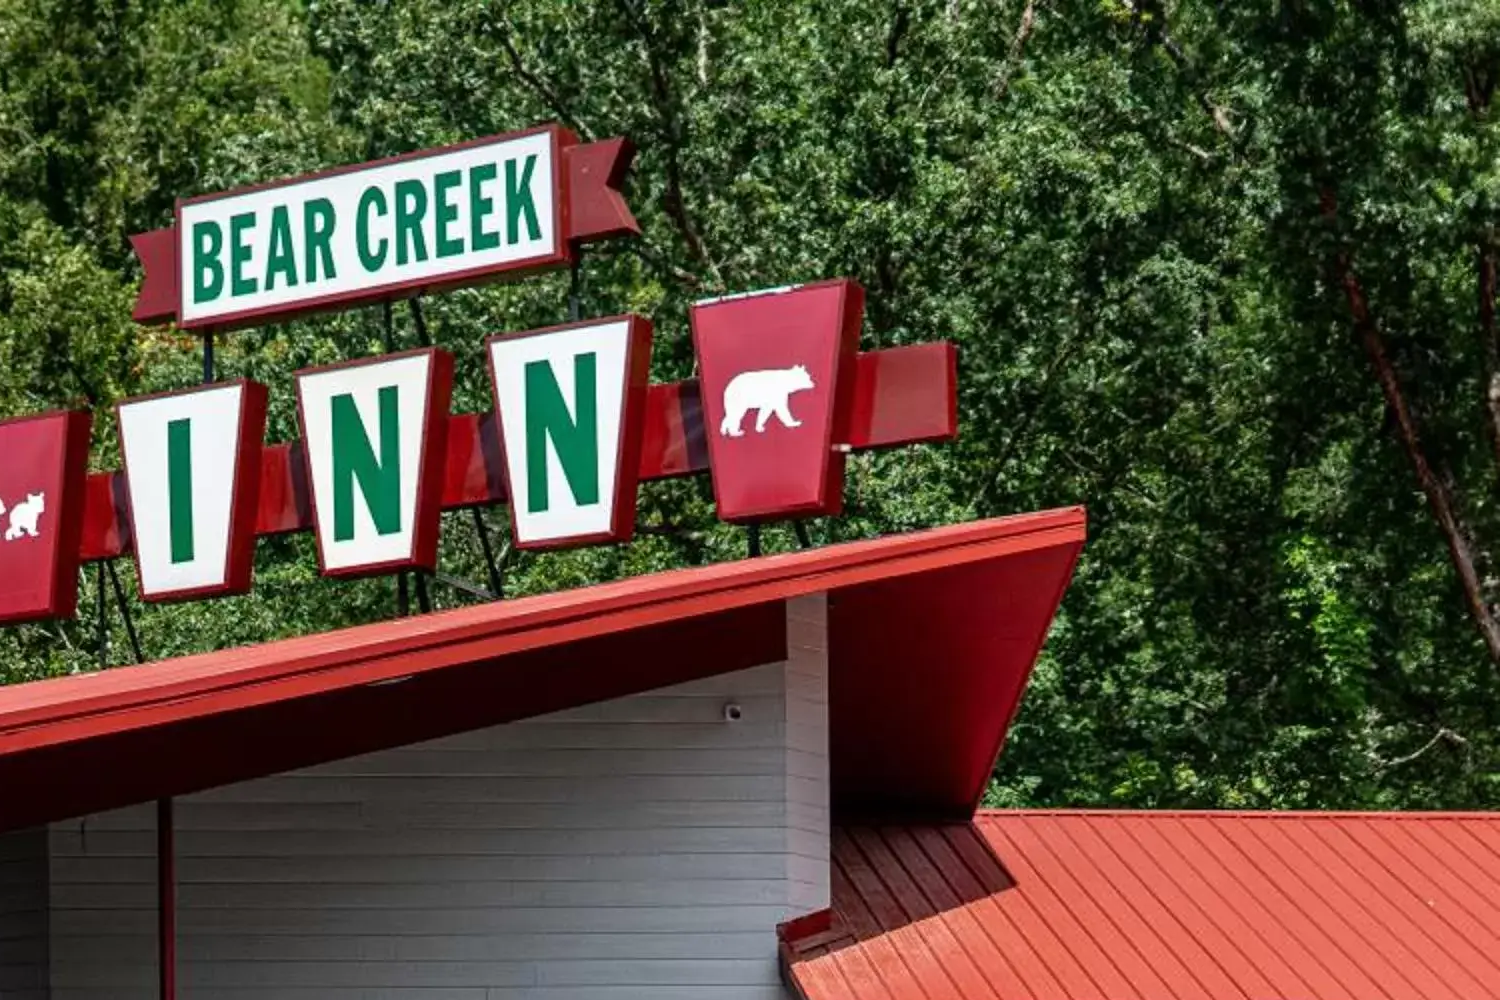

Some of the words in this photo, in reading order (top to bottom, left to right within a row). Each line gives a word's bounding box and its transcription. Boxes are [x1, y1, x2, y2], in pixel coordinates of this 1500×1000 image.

[192, 188, 336, 304] BEAR
[356, 155, 542, 274] CREEK
[168, 354, 600, 565] INN
